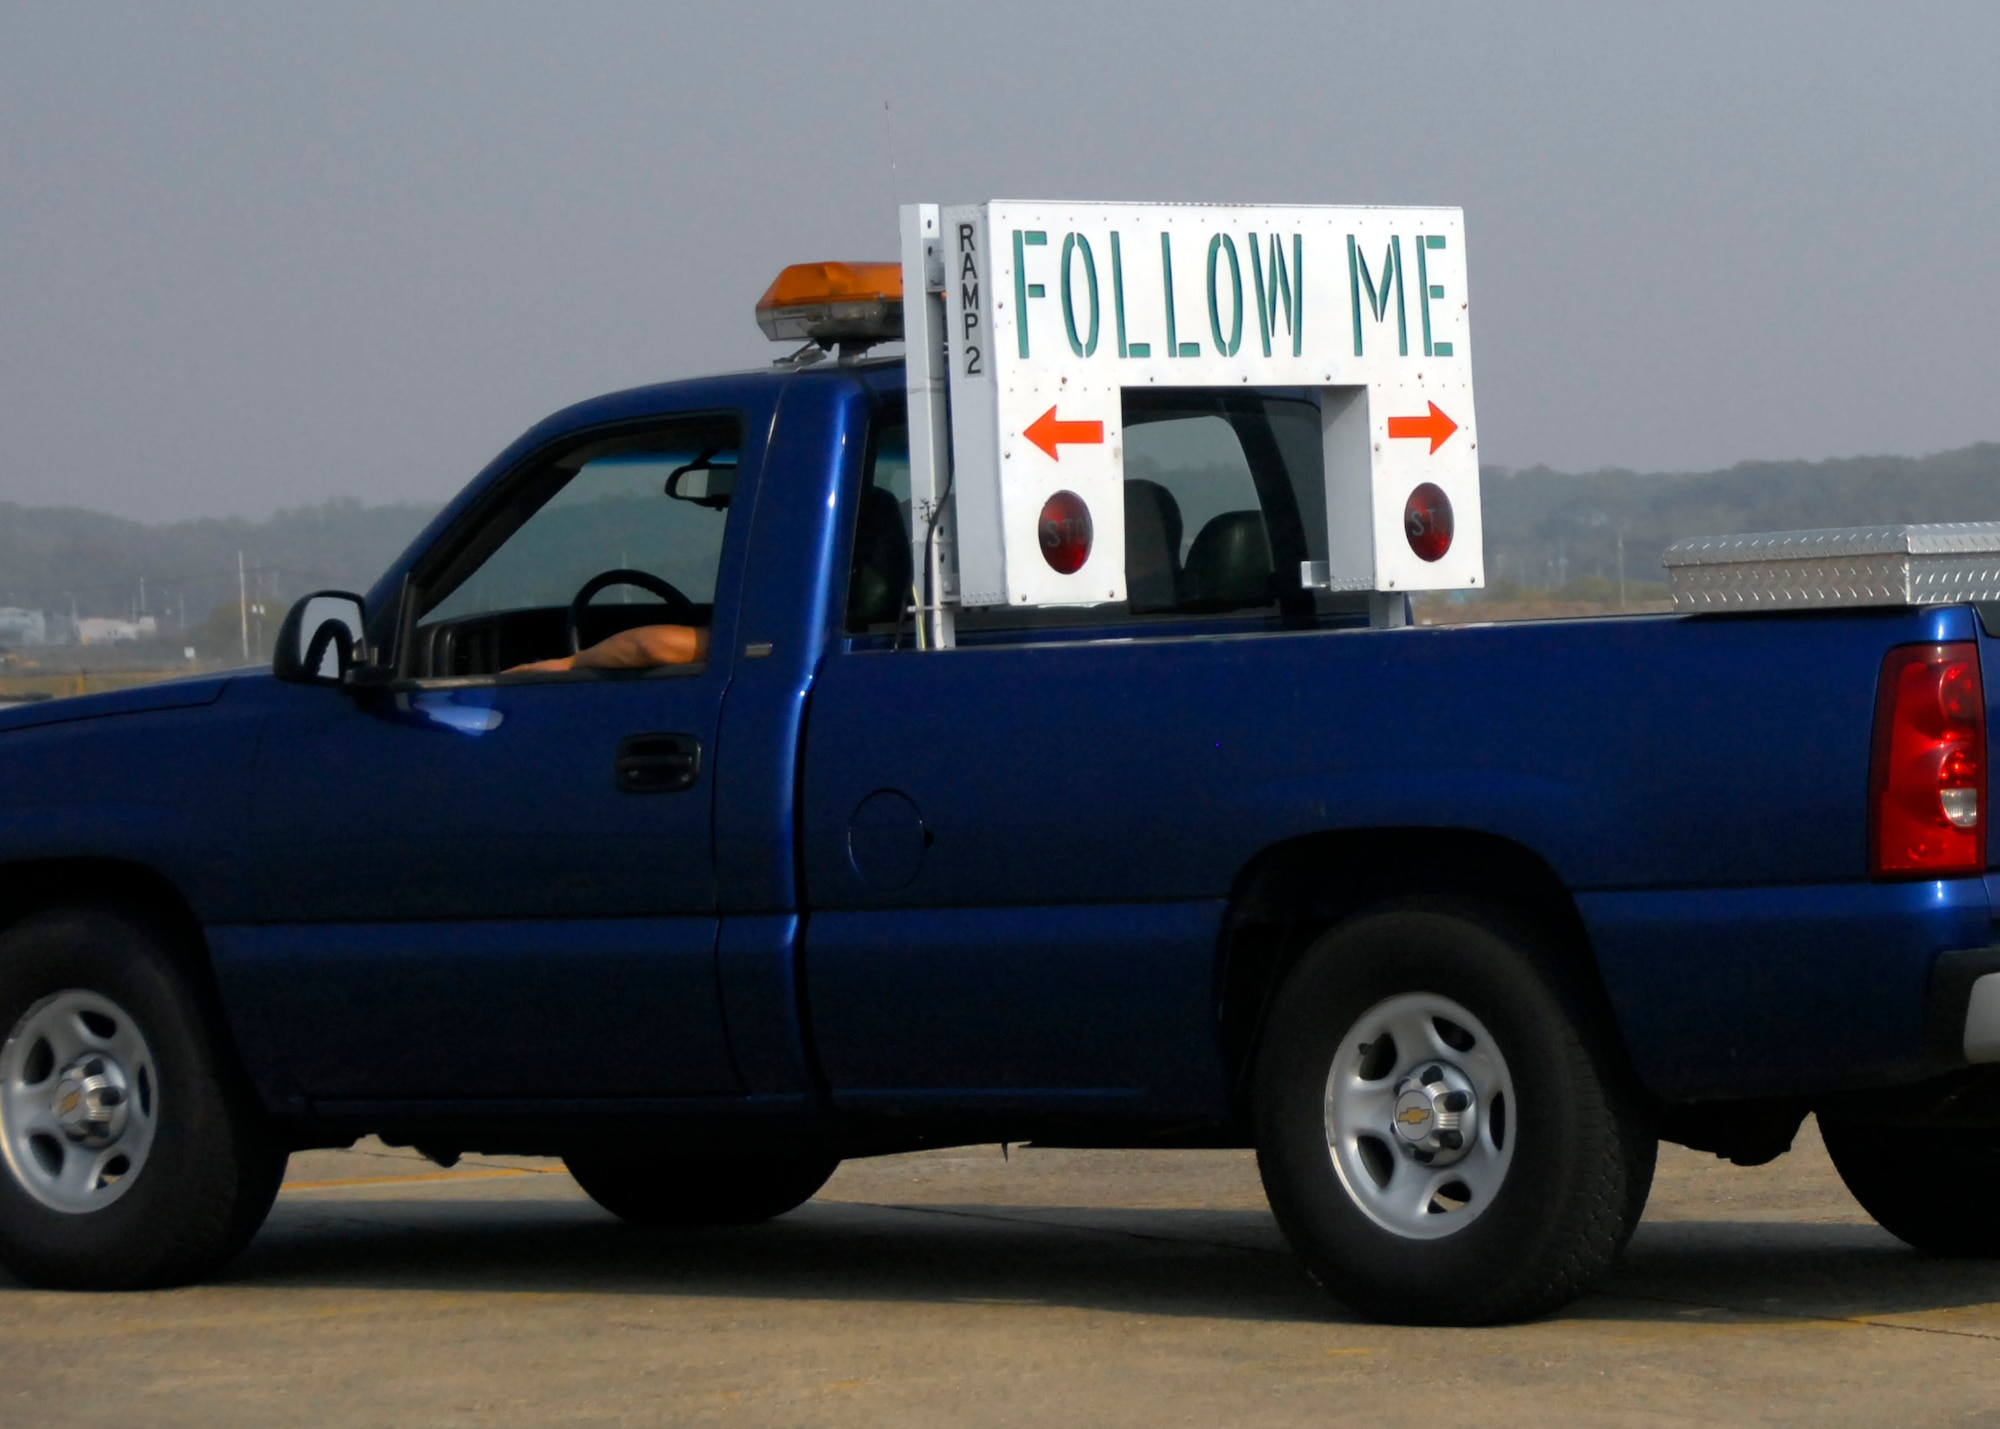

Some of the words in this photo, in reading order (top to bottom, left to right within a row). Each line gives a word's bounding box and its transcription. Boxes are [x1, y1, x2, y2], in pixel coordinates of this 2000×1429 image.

[958, 223, 980, 341] RAMP
[1012, 229, 1303, 359] FOLLOW
[1346, 233, 1454, 357] ME
[965, 345, 982, 375] 2
[1046, 517, 1088, 549] STO
